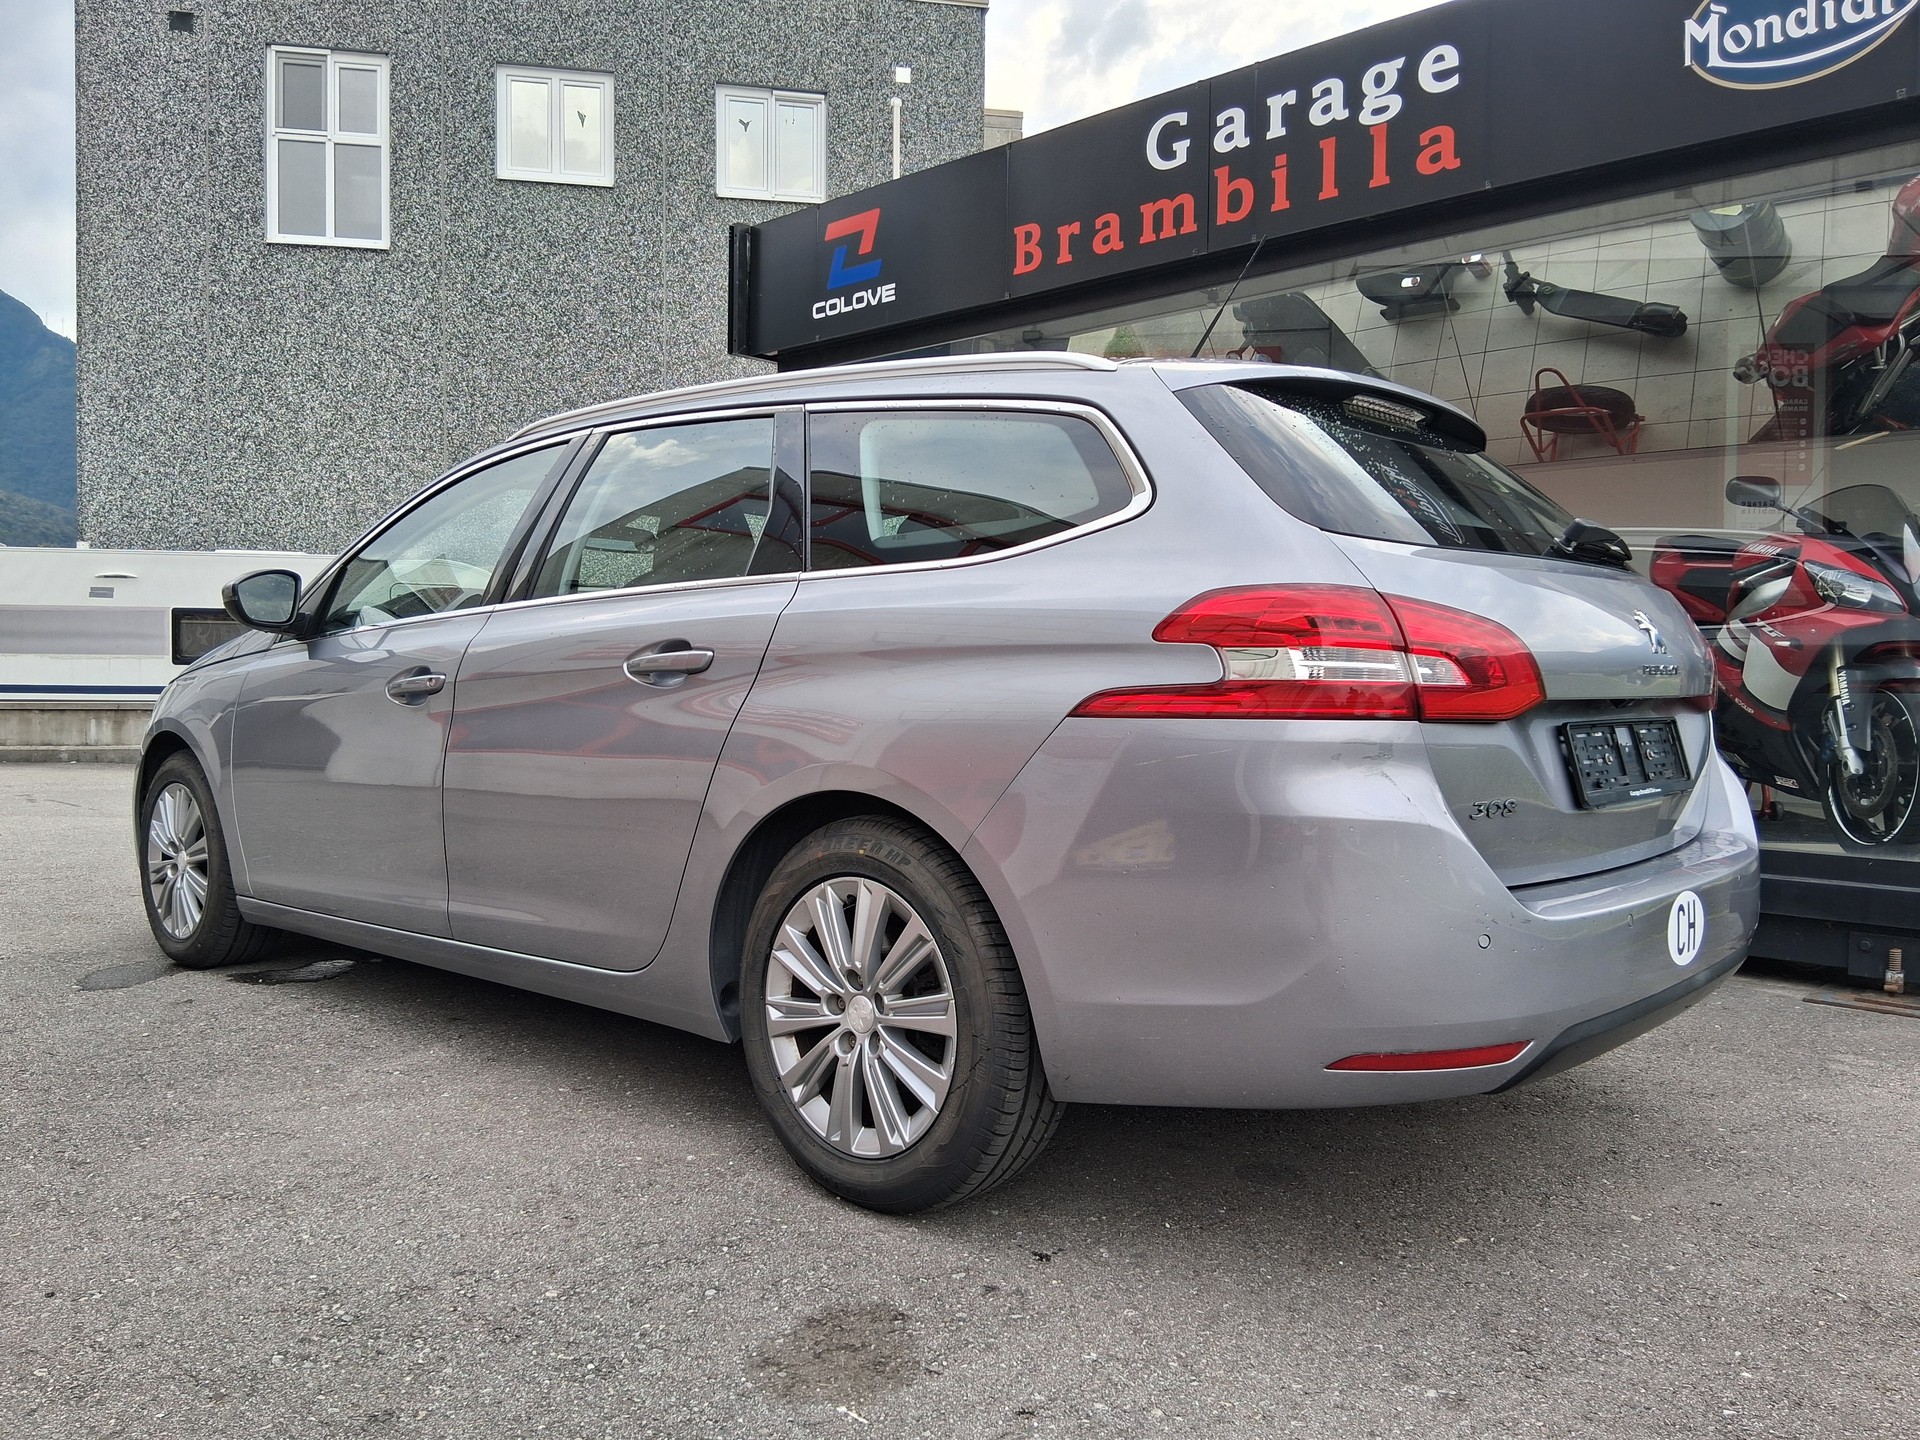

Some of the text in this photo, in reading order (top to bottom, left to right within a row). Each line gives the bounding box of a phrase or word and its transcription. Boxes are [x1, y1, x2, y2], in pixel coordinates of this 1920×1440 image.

[1145, 43, 1460, 171] Garage
[1012, 122, 1461, 275] Brambilla
[812, 282, 896, 320] COLOVE
[1743, 543, 1783, 557] YAMAHA
[1836, 670, 1851, 706] YAMAHA
[1469, 798, 1517, 821] 308
[1677, 899, 1696, 956] CH
